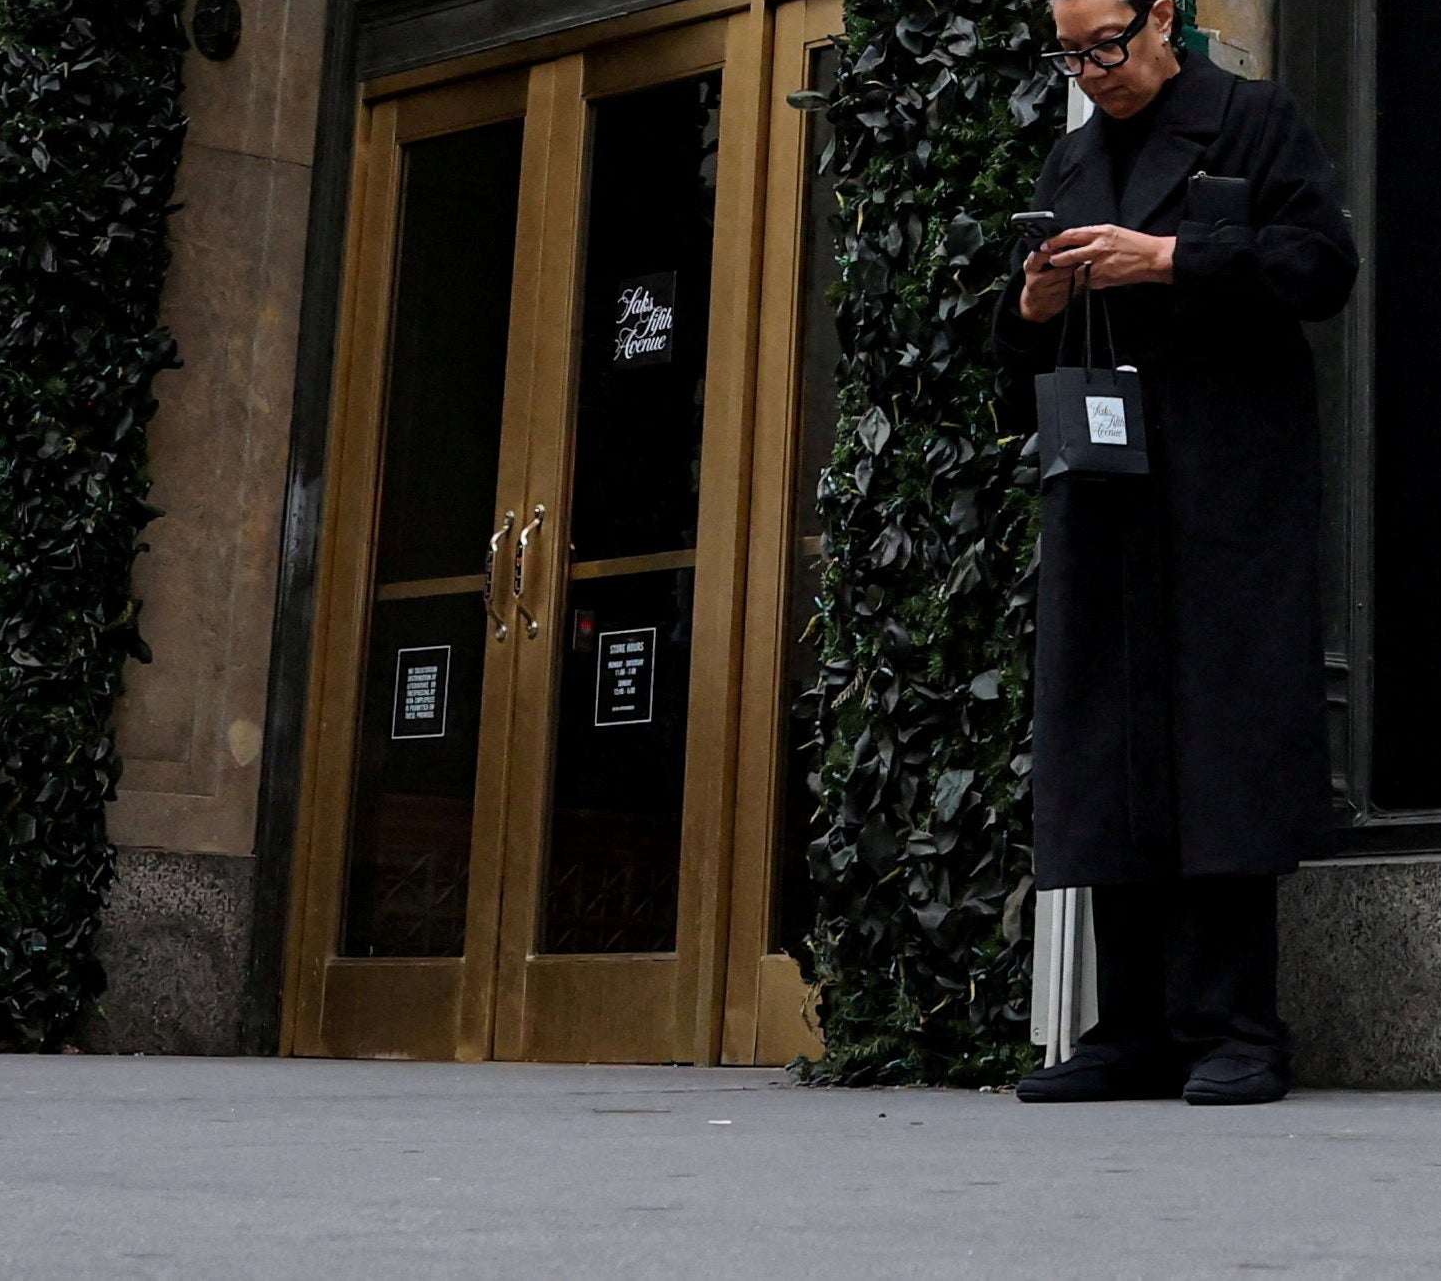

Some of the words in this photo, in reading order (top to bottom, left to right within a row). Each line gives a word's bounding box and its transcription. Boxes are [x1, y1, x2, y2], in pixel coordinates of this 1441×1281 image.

[616, 286, 654, 324] Saks
[634, 305, 673, 339] Fifth
[613, 327, 667, 361] Avenue
[627, 642, 644, 652] HOURS
